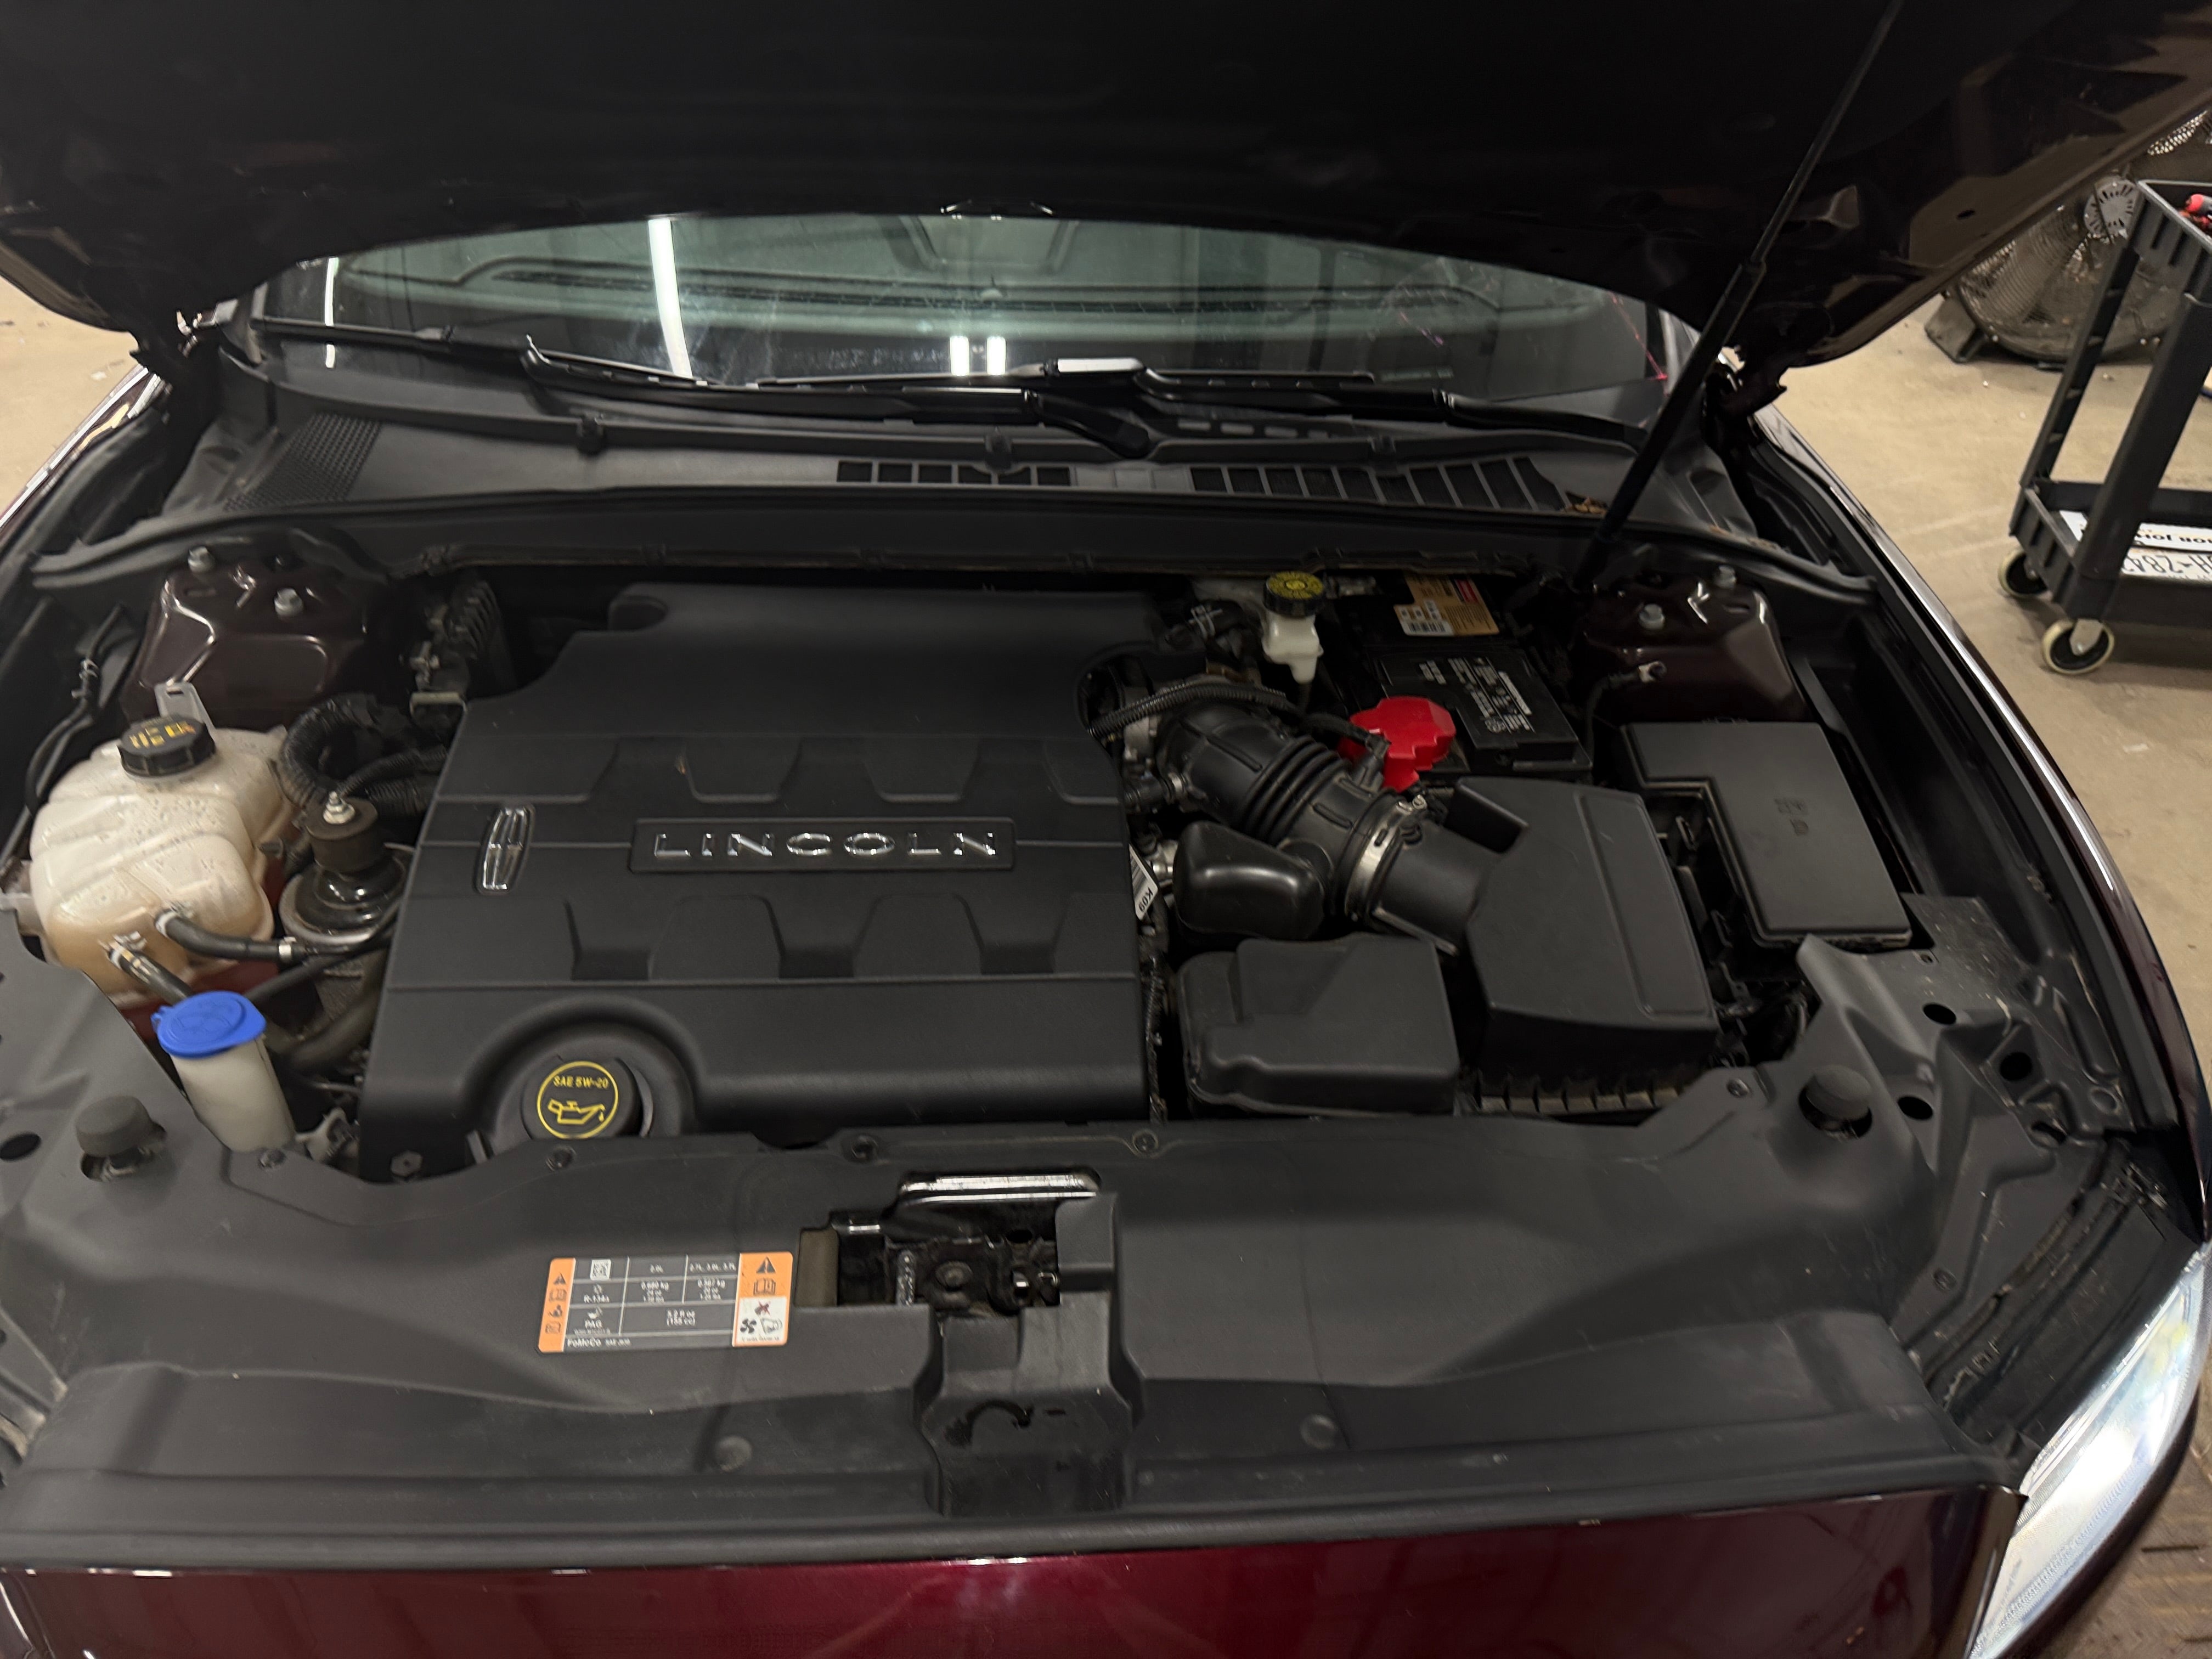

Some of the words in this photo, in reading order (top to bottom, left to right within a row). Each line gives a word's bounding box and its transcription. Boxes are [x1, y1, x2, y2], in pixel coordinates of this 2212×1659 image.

[654, 832, 997, 859] LINCOLN
[553, 1075, 574, 1088] SAE
[575, 1075, 610, 1090] 5W-20
